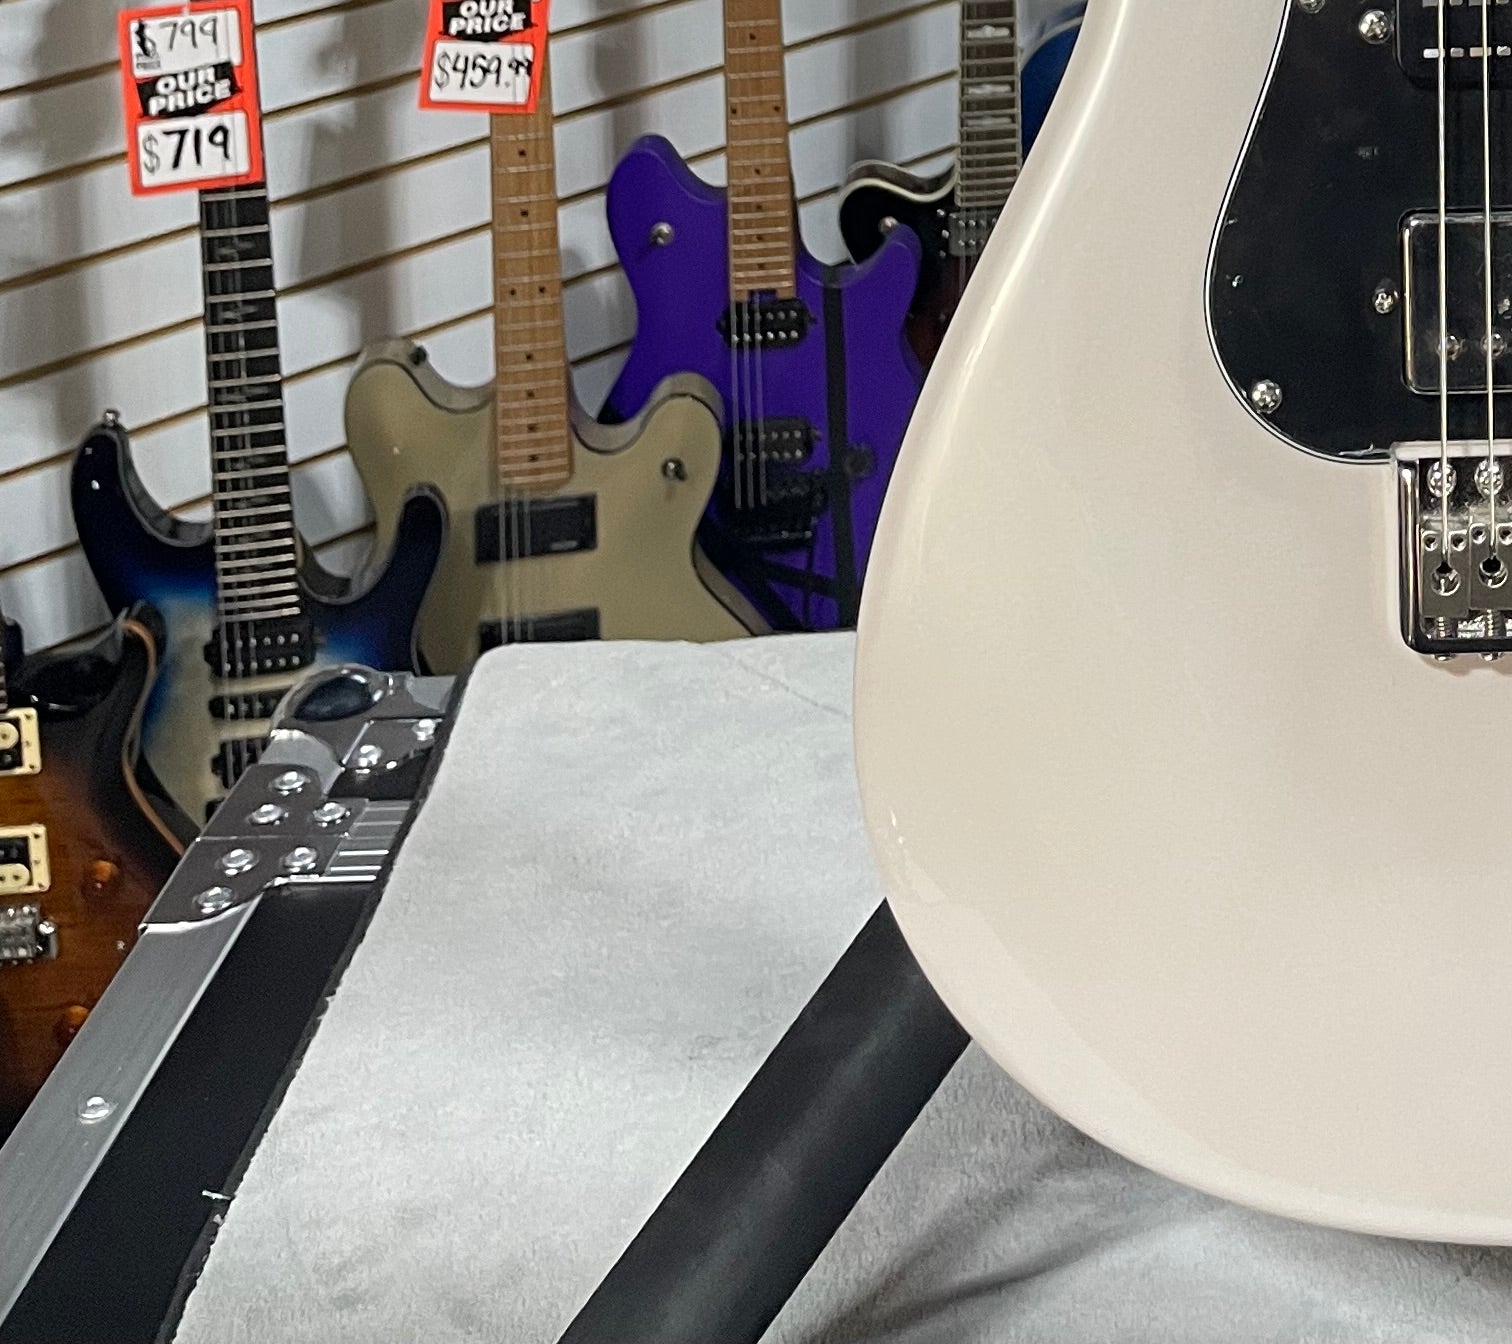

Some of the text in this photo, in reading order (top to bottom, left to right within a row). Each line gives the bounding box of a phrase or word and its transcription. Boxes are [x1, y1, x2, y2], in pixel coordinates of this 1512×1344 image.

[448, 12, 527, 37] PRICE
[147, 78, 233, 117] PRICE
[155, 66, 216, 97] OUR
[141, 124, 231, 175] $719
